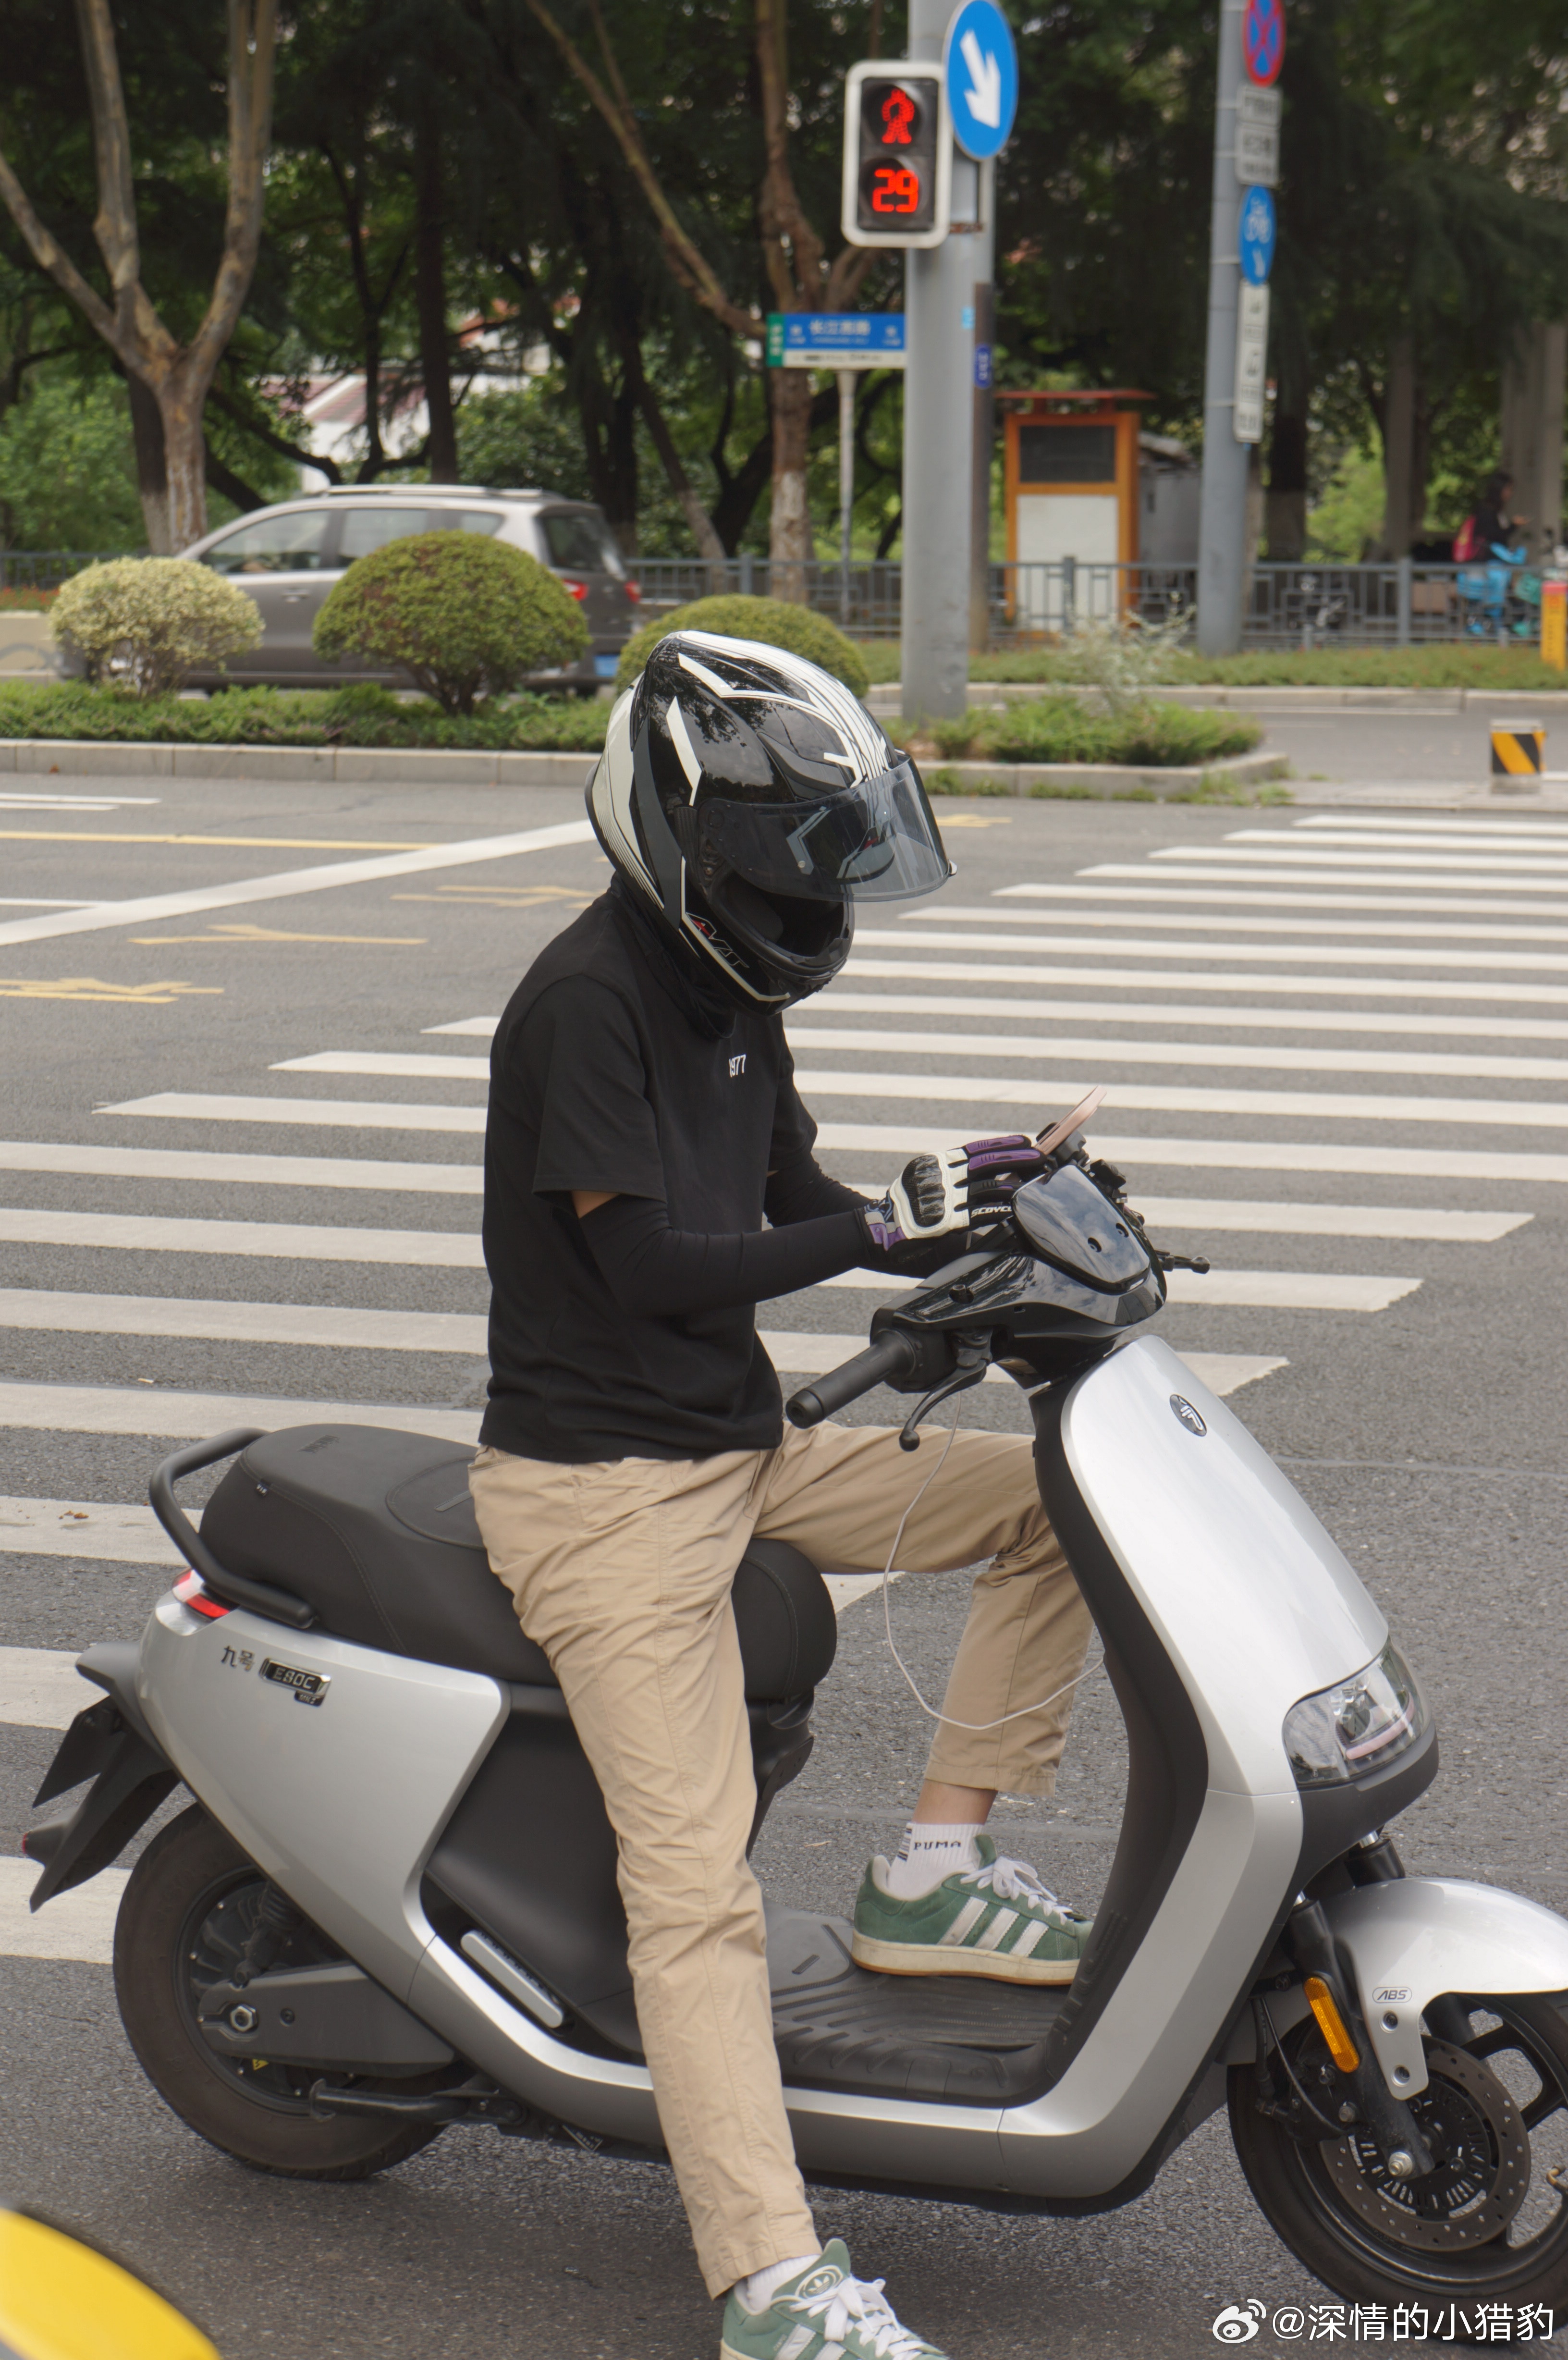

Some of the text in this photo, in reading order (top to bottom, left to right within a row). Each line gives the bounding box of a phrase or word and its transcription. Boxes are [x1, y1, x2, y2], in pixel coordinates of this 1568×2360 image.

[872, 168, 919, 213] 29
[728, 1053, 747, 1078] 1977
[221, 1645, 255, 1672] 九号
[272, 1666, 316, 1690] E80C
[913, 1841, 961, 1850] PUMA
[1377, 1990, 1408, 2000] ABS
